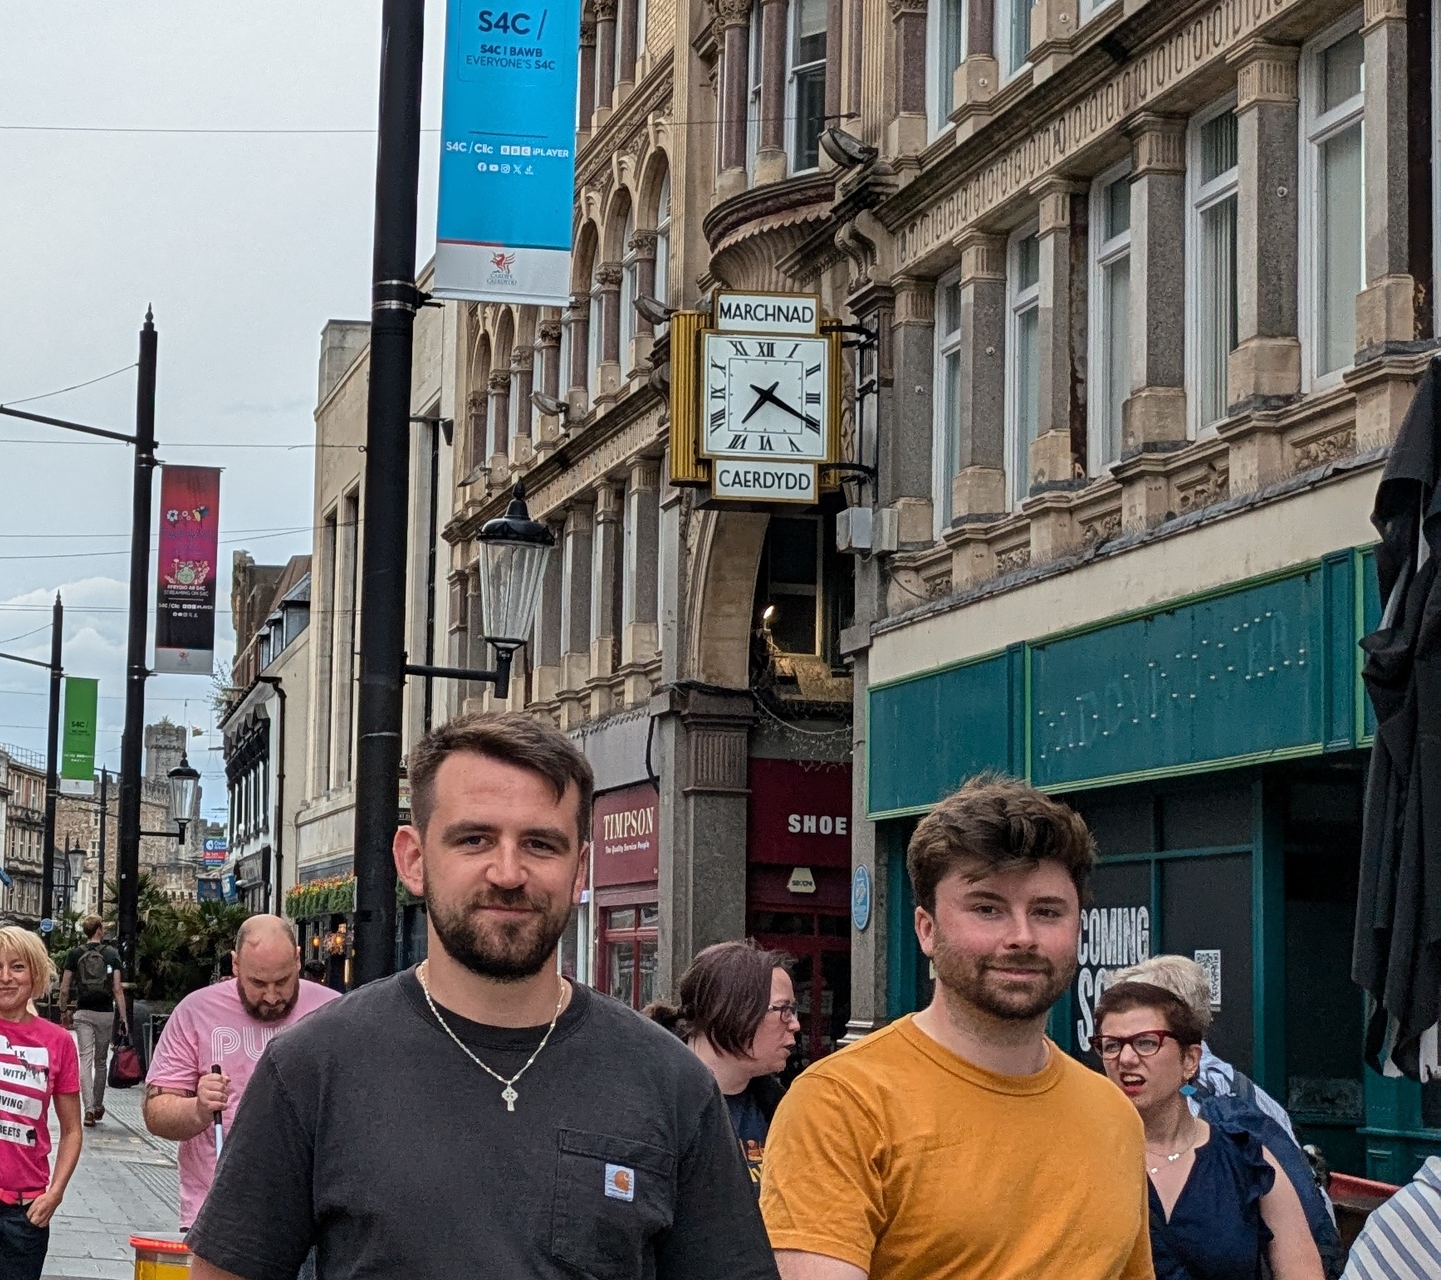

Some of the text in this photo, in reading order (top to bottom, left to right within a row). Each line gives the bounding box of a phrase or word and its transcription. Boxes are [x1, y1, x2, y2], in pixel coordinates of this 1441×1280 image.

[478, 10, 530, 35] S4C
[480, 44, 501, 55] S4C
[510, 47, 543, 58] BAWB
[466, 55, 556, 70] EVERYONE'S S4C
[532, 147, 569, 158] iPLAYER
[719, 301, 814, 324] MARCHNAD
[718, 469, 811, 490] CAERDYDD
[603, 807, 654, 840] TIMPSON
[788, 814, 847, 835] SHOE
[1077, 906, 1150, 966] COMING
[2, 1067, 27, 1081] WITH
